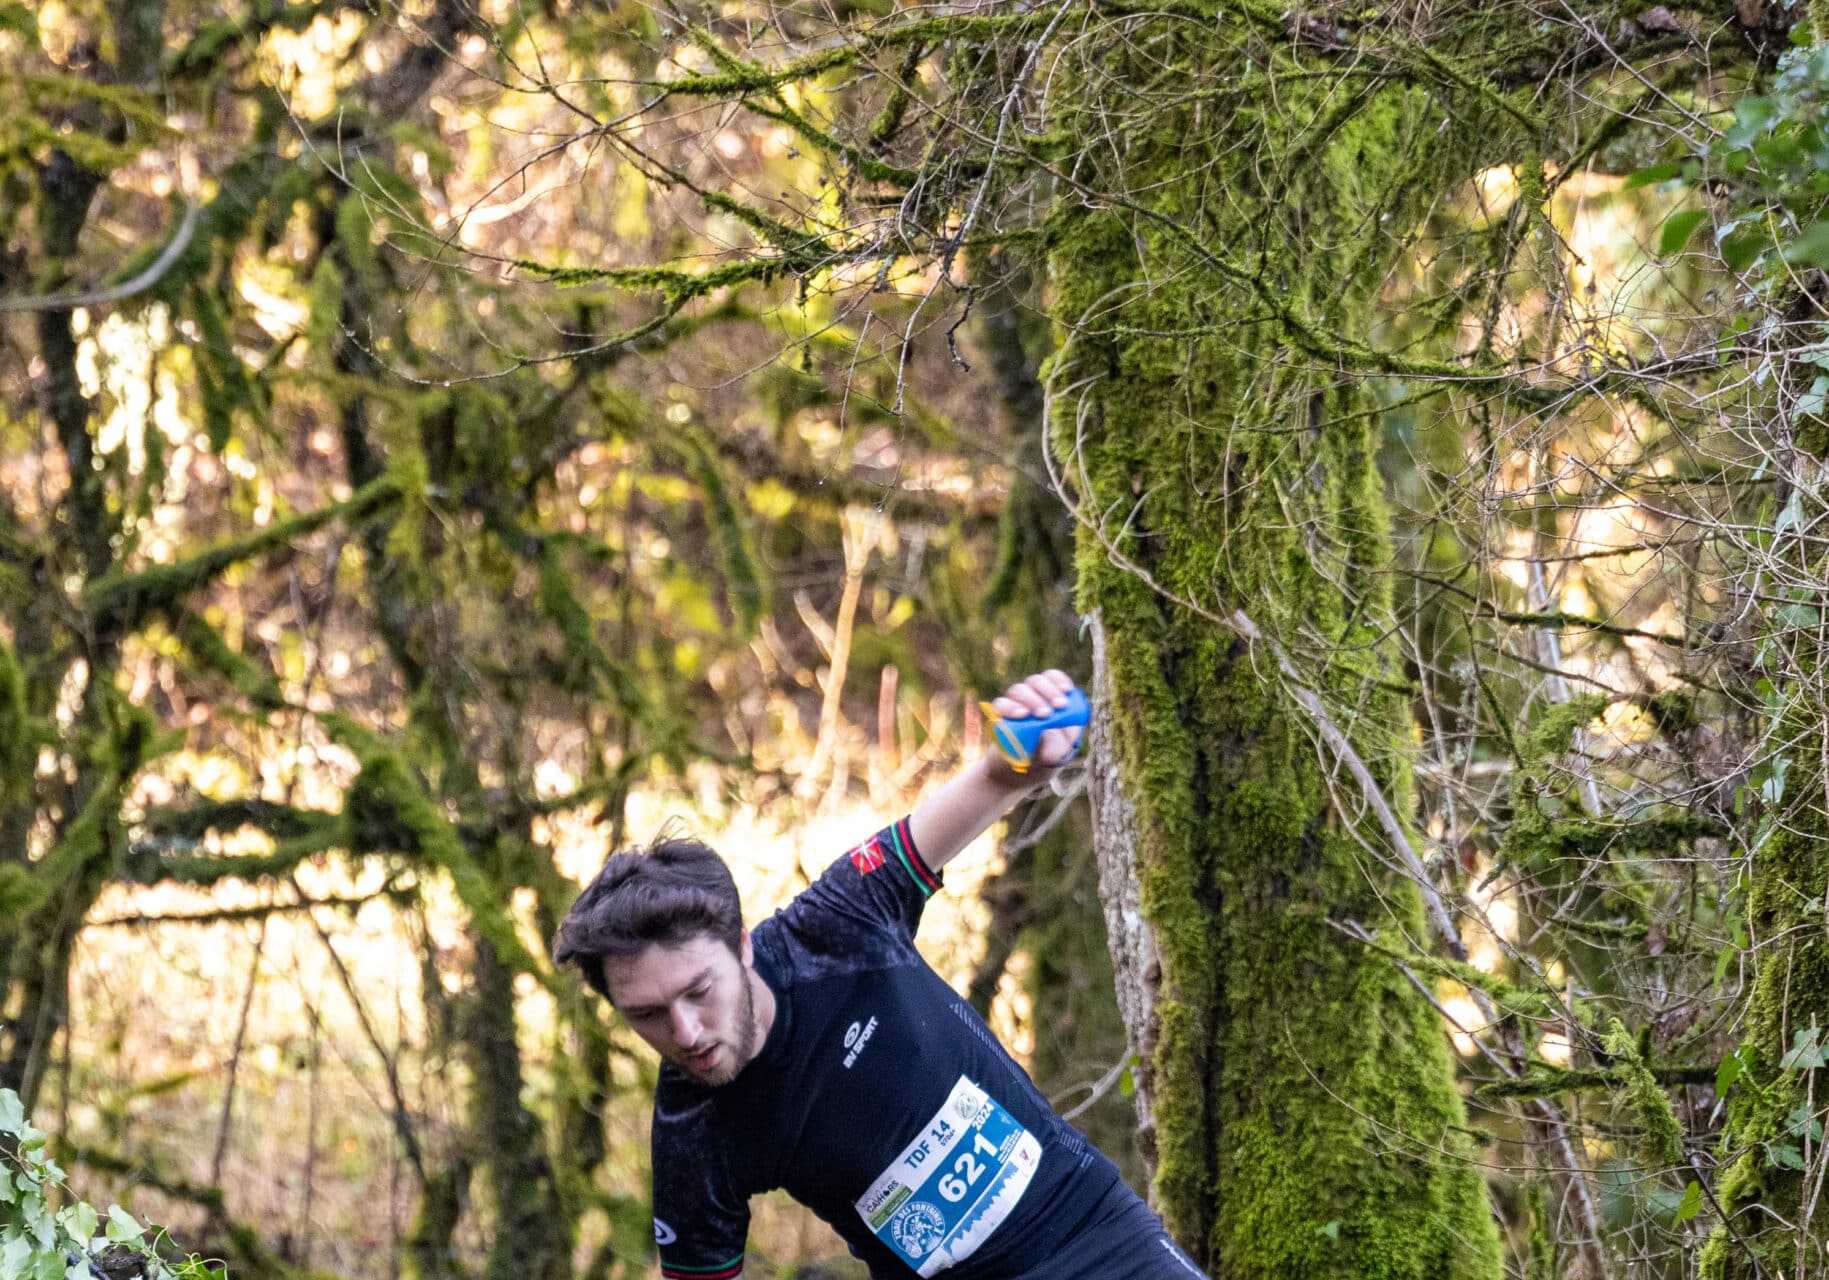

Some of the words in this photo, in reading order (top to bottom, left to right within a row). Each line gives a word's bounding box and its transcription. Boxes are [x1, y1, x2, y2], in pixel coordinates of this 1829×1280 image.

[853, 1015, 879, 1054] SPORT
[971, 1102, 996, 1131] 2024
[903, 1139, 932, 1169] TDF
[931, 1119, 951, 1143] 14
[937, 1132, 999, 1203] 621
